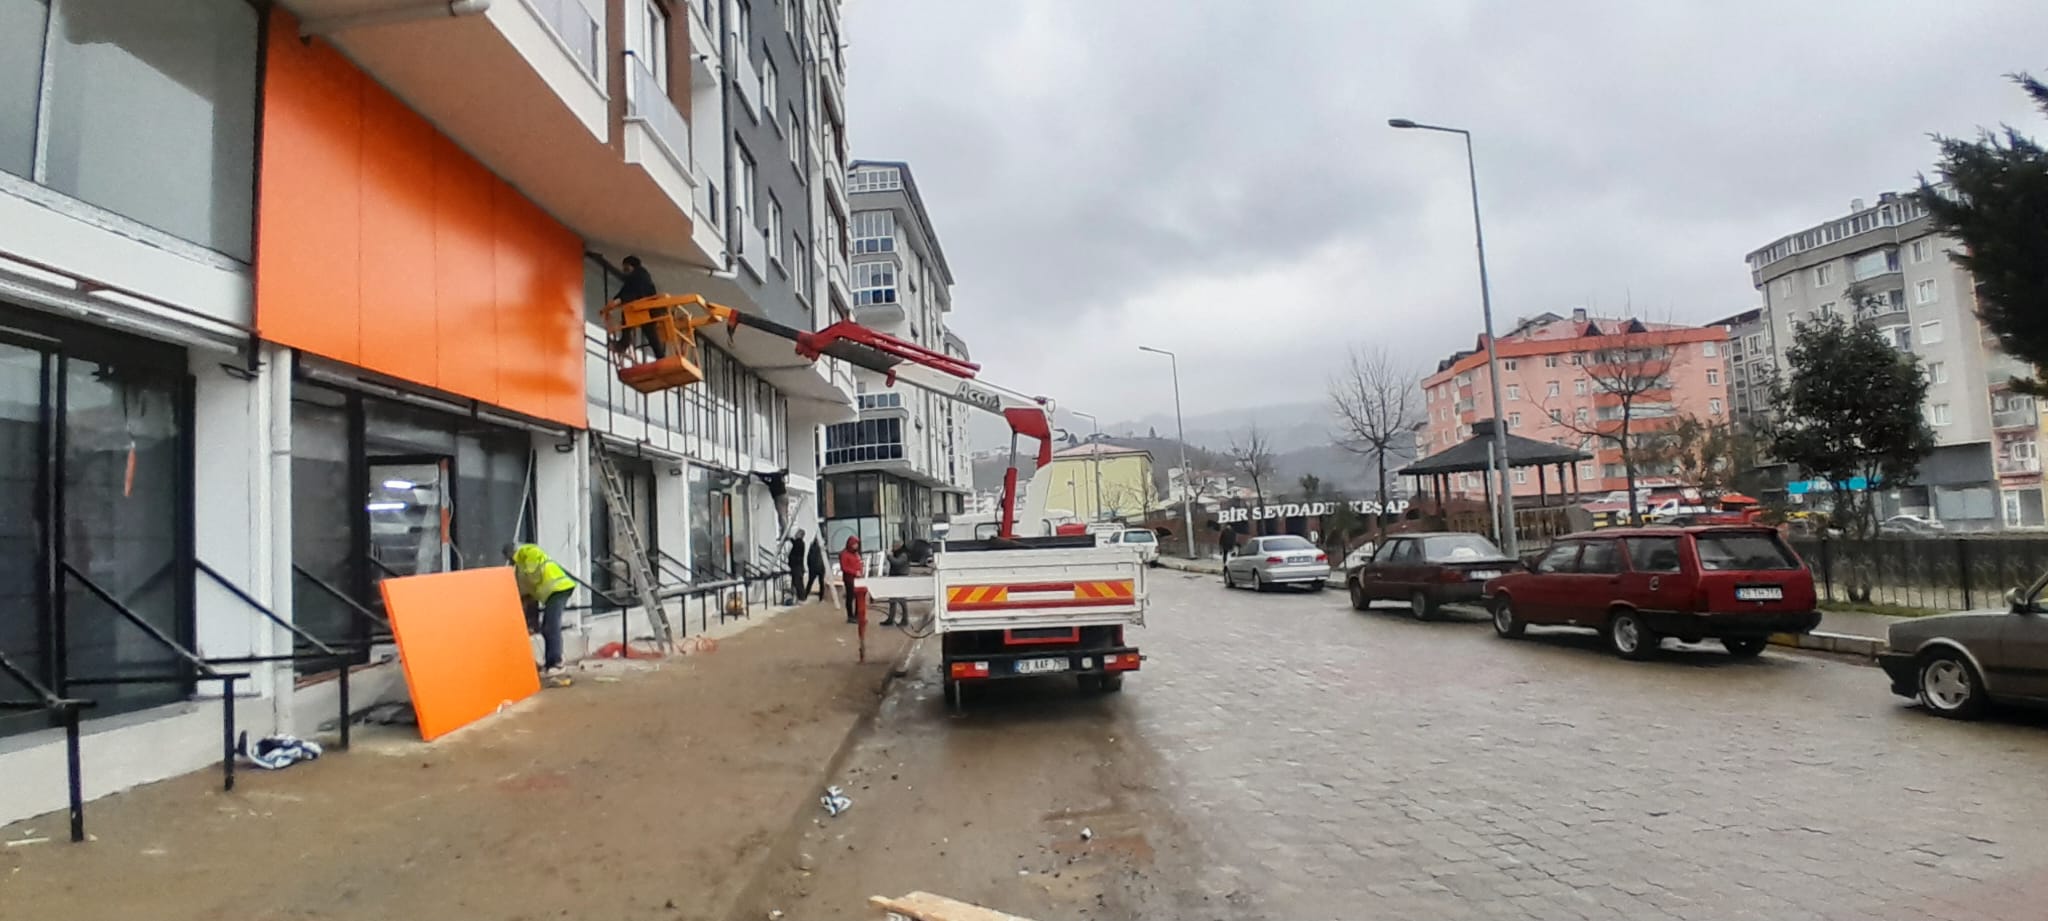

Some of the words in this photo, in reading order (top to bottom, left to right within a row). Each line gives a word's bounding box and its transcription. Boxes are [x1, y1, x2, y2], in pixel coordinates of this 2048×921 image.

[1218, 507, 1248, 523] BİR
[1252, 502, 1341, 520] SEVDADU
[1348, 500, 1410, 516] KEŞAP
